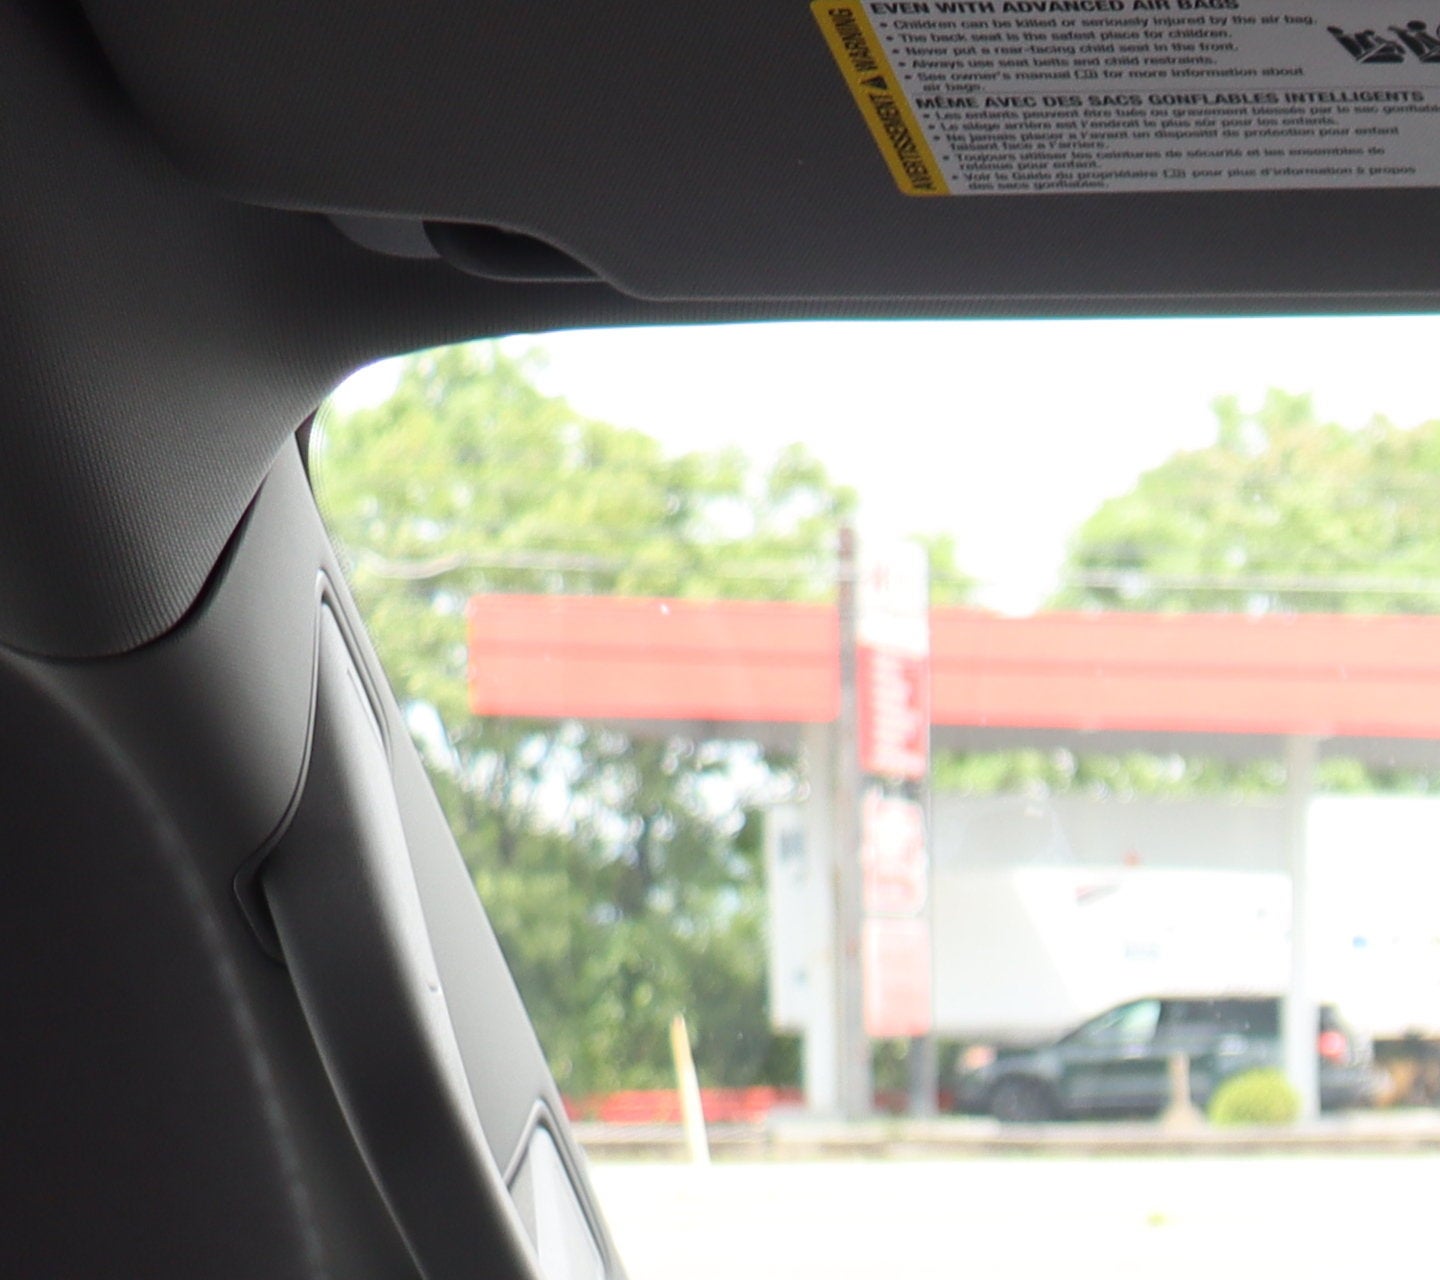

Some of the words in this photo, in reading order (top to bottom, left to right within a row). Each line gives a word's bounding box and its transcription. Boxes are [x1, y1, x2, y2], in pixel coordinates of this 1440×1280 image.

[870, 2, 929, 14] EVEN
[936, 1, 994, 13] WITH
[1003, 0, 1124, 12] ADVANCED
[1133, 0, 1170, 10] AIR
[1178, 0, 1239, 10] BAGS
[985, 96, 1036, 108] AVEC
[1044, 96, 1081, 107] DES
[1088, 94, 1142, 106] SACS
[1149, 93, 1279, 105] GONFLABLES
[1285, 92, 1425, 103] INTELLIGENTS
